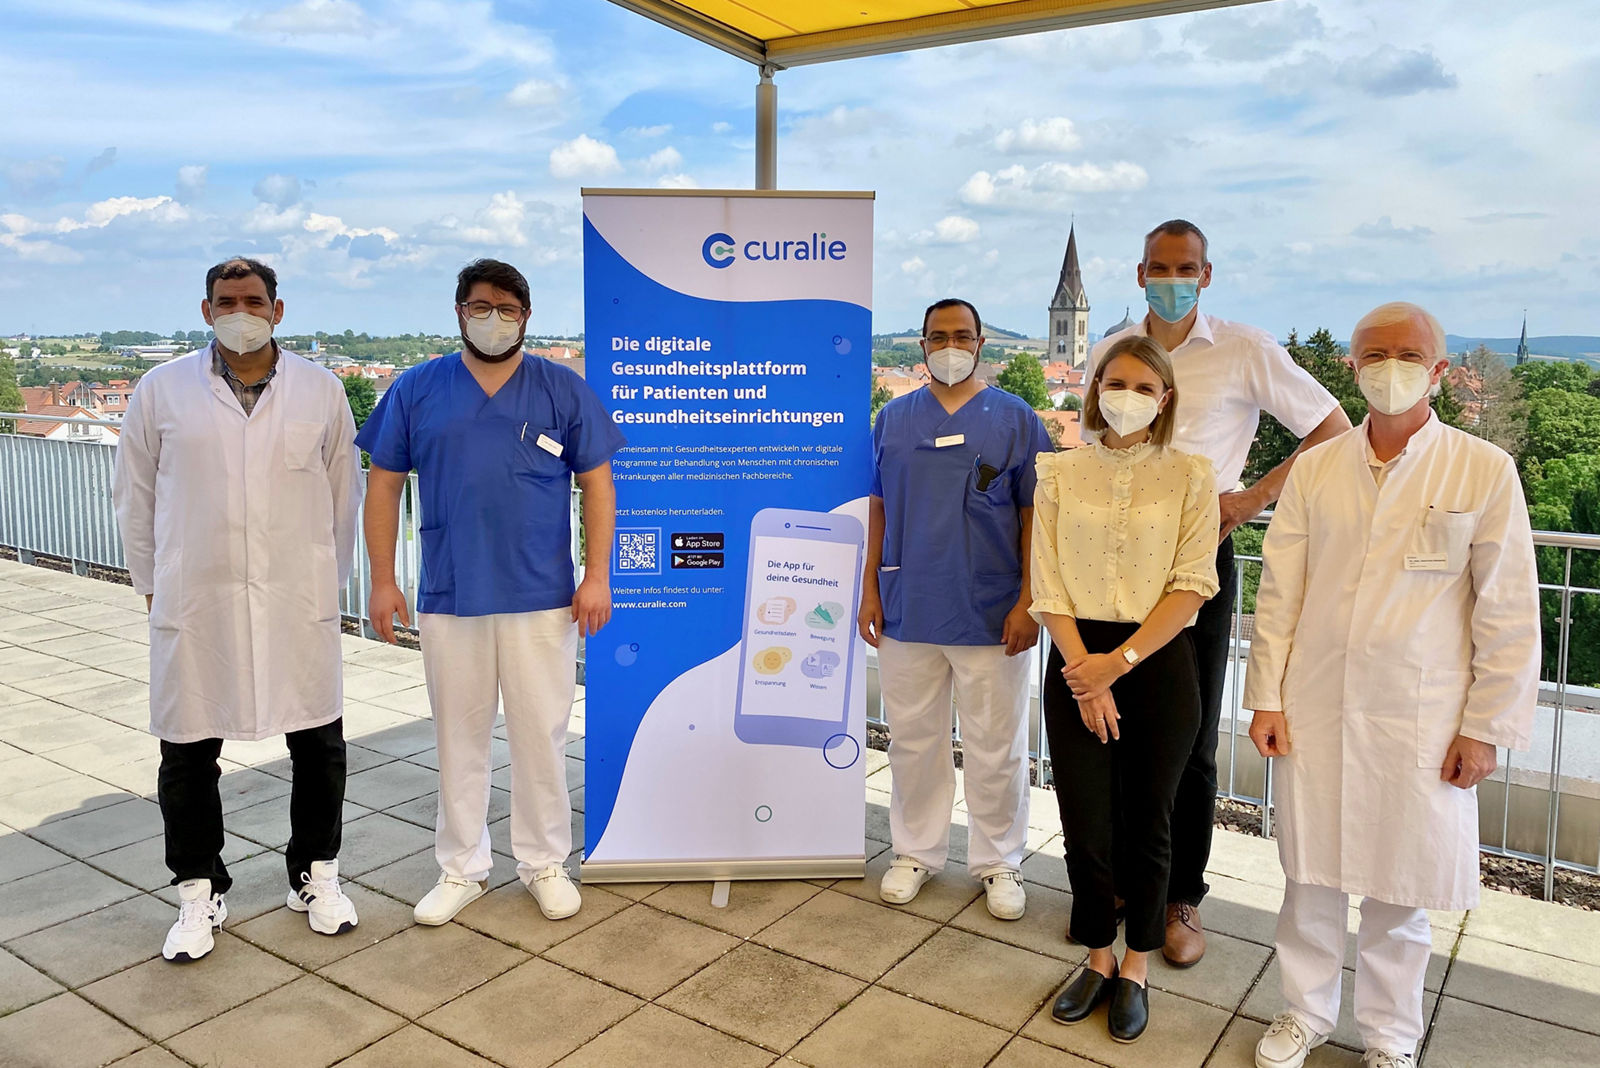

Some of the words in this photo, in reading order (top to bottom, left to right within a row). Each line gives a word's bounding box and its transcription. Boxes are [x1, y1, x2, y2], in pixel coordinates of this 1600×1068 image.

[744, 232, 847, 260] curalie
[612, 336, 640, 351] Die
[645, 336, 712, 355] digitale
[611, 361, 807, 379] Gesundheitsplattform
[611, 385, 638, 400] für
[643, 385, 728, 400] Patienten
[734, 385, 767, 400] und
[612, 409, 844, 427] Gesundheitseinrichtungen
[676, 445, 758, 454] Gesundheitsexperten
[816, 445, 843, 454] digitale
[612, 460, 658, 468] Programme
[674, 459, 720, 468] Behandlung
[612, 473, 666, 482] Erkrankungen
[742, 472, 794, 480] Fachbereiche.
[686, 540, 700, 548] App
[768, 560, 782, 568] Die
[783, 561, 800, 571] App
[802, 562, 815, 572] für
[766, 574, 790, 582] deine
[792, 575, 838, 588] Gesundheit
